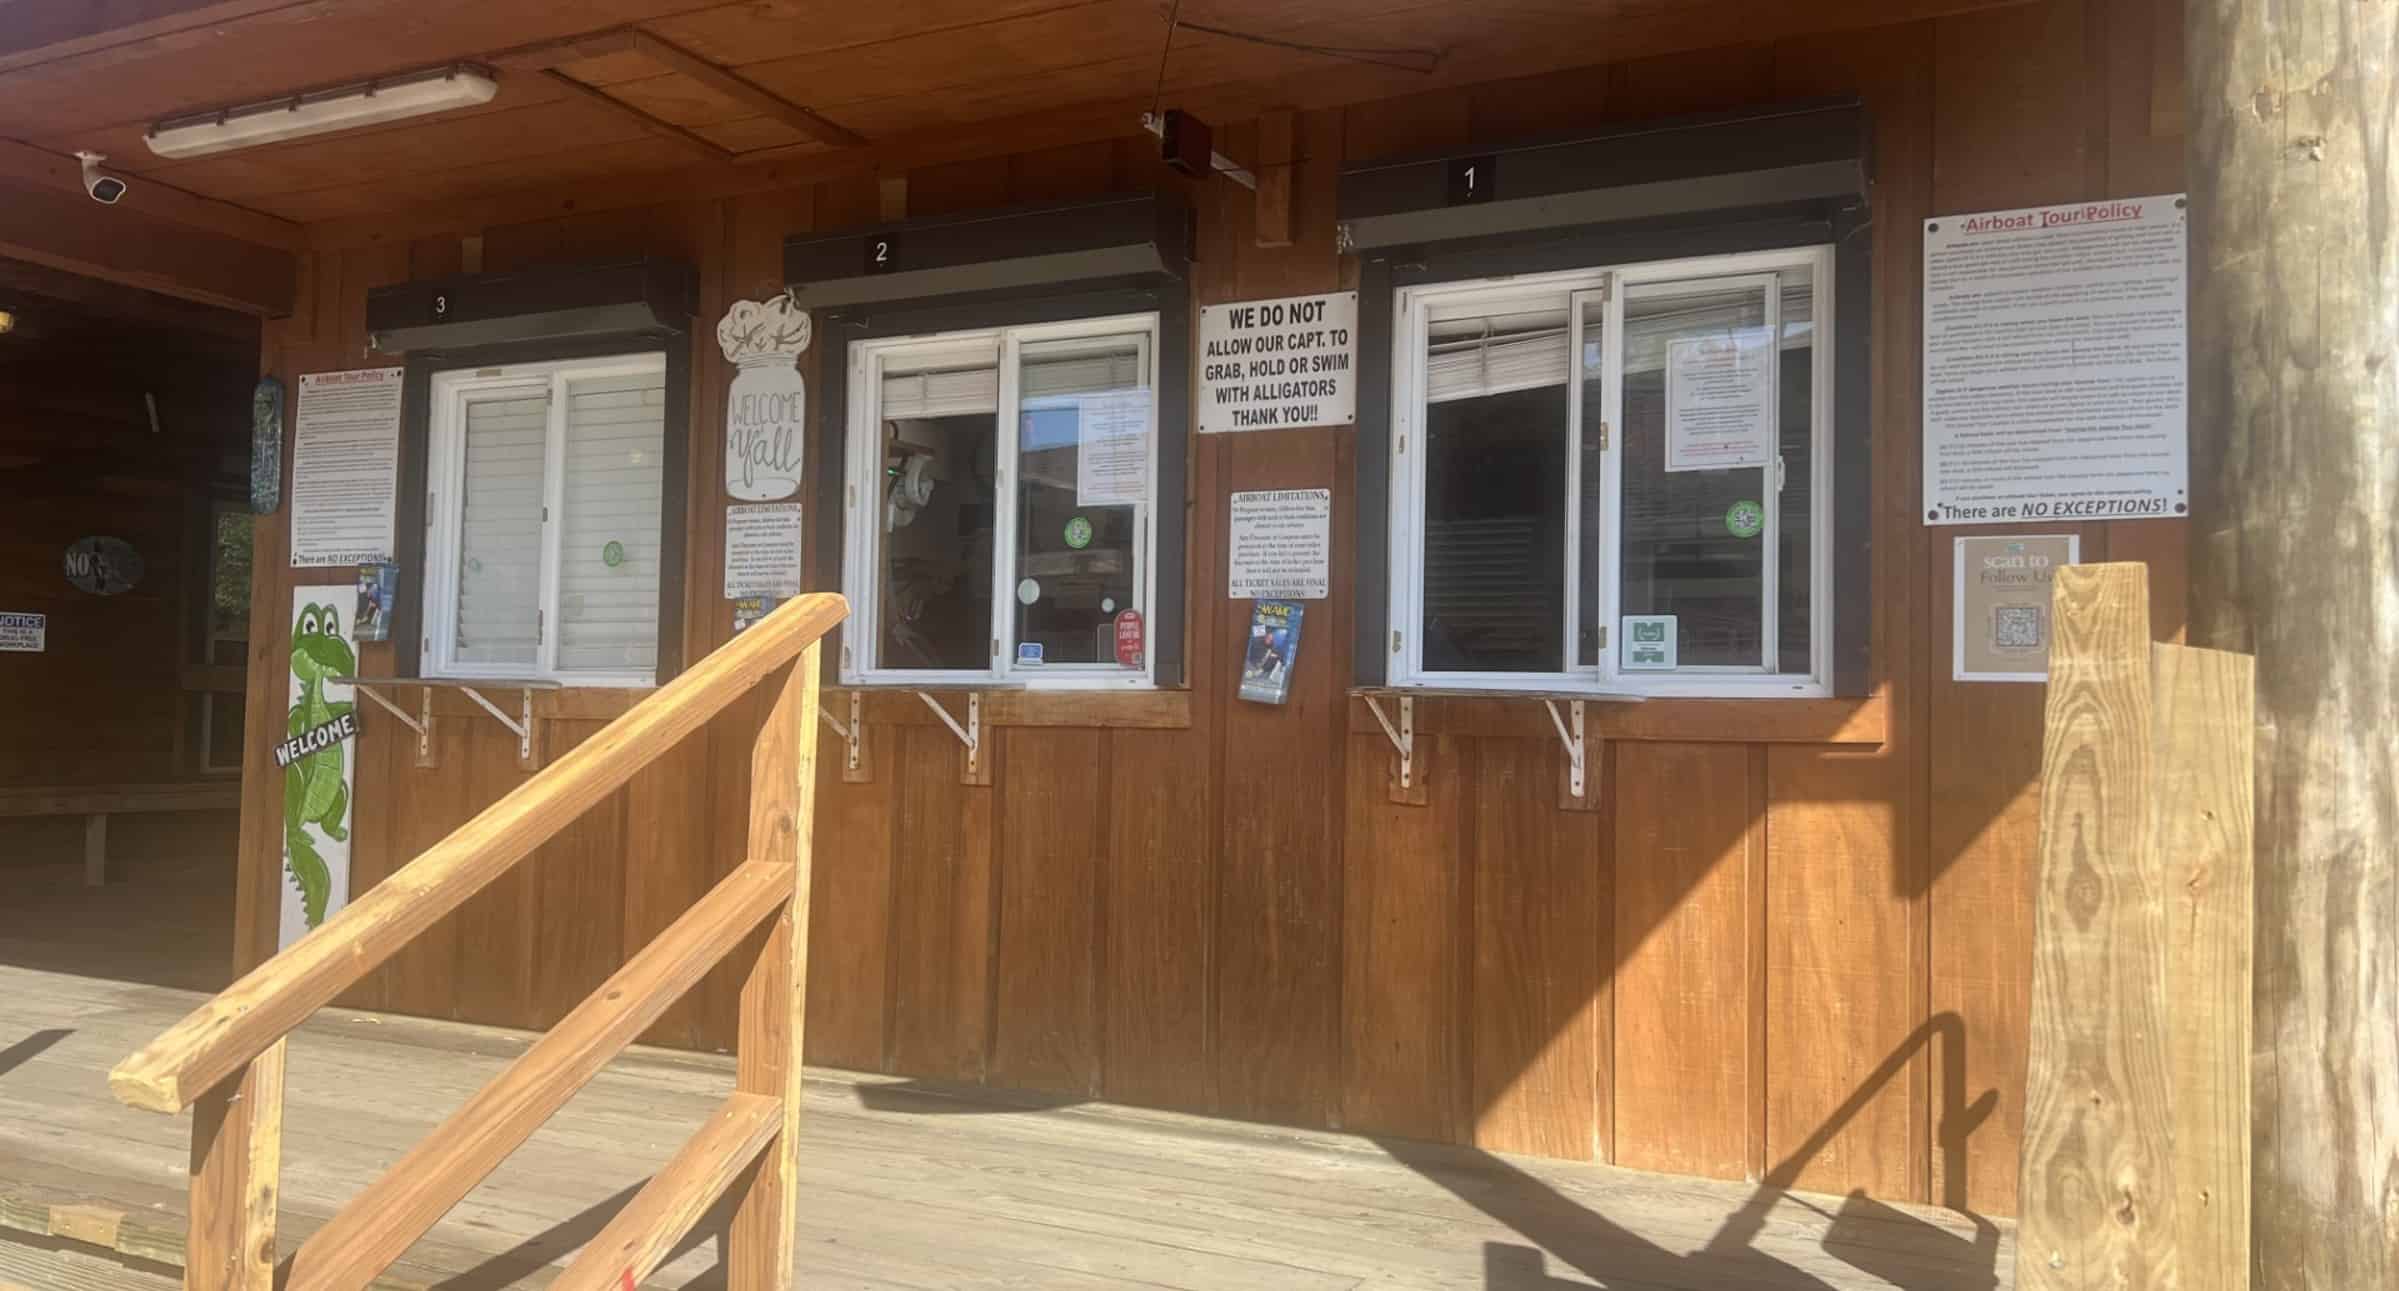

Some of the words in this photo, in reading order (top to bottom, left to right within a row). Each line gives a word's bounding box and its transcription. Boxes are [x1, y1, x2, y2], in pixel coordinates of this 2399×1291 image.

[1465, 166, 1475, 189] 1
[1966, 212, 2033, 233] Airboat
[2042, 210, 2081, 228] Tour
[2087, 204, 2142, 222] Policy
[876, 241, 887, 261] 2
[436, 296, 445, 313] 3
[1230, 307, 1254, 330] WE
[1260, 305, 1283, 327] DO
[1290, 301, 1325, 324] NOT
[1207, 338, 1252, 357] ALLOW
[1256, 335, 1283, 352] OUR
[1288, 332, 1325, 349] CAPT.
[1330, 329, 1348, 346] TO
[1206, 362, 1245, 381] GRAB,
[1250, 359, 1284, 378] HOLD
[1289, 357, 1308, 374] OR
[1312, 354, 1349, 372] SWIM
[1216, 386, 1249, 404] WITH
[1253, 379, 1336, 401] ALLIGATORS
[732, 391, 801, 427] WELCOME
[1232, 407, 1278, 426] THANK
[1282, 404, 1318, 423] YOU!!
[1944, 504, 1988, 519] There
[1992, 506, 2016, 518] are
[2022, 502, 2048, 517] NO
[2053, 498, 2168, 516] EXCEPTIONS!
[276, 714, 355, 767] WELCOME
